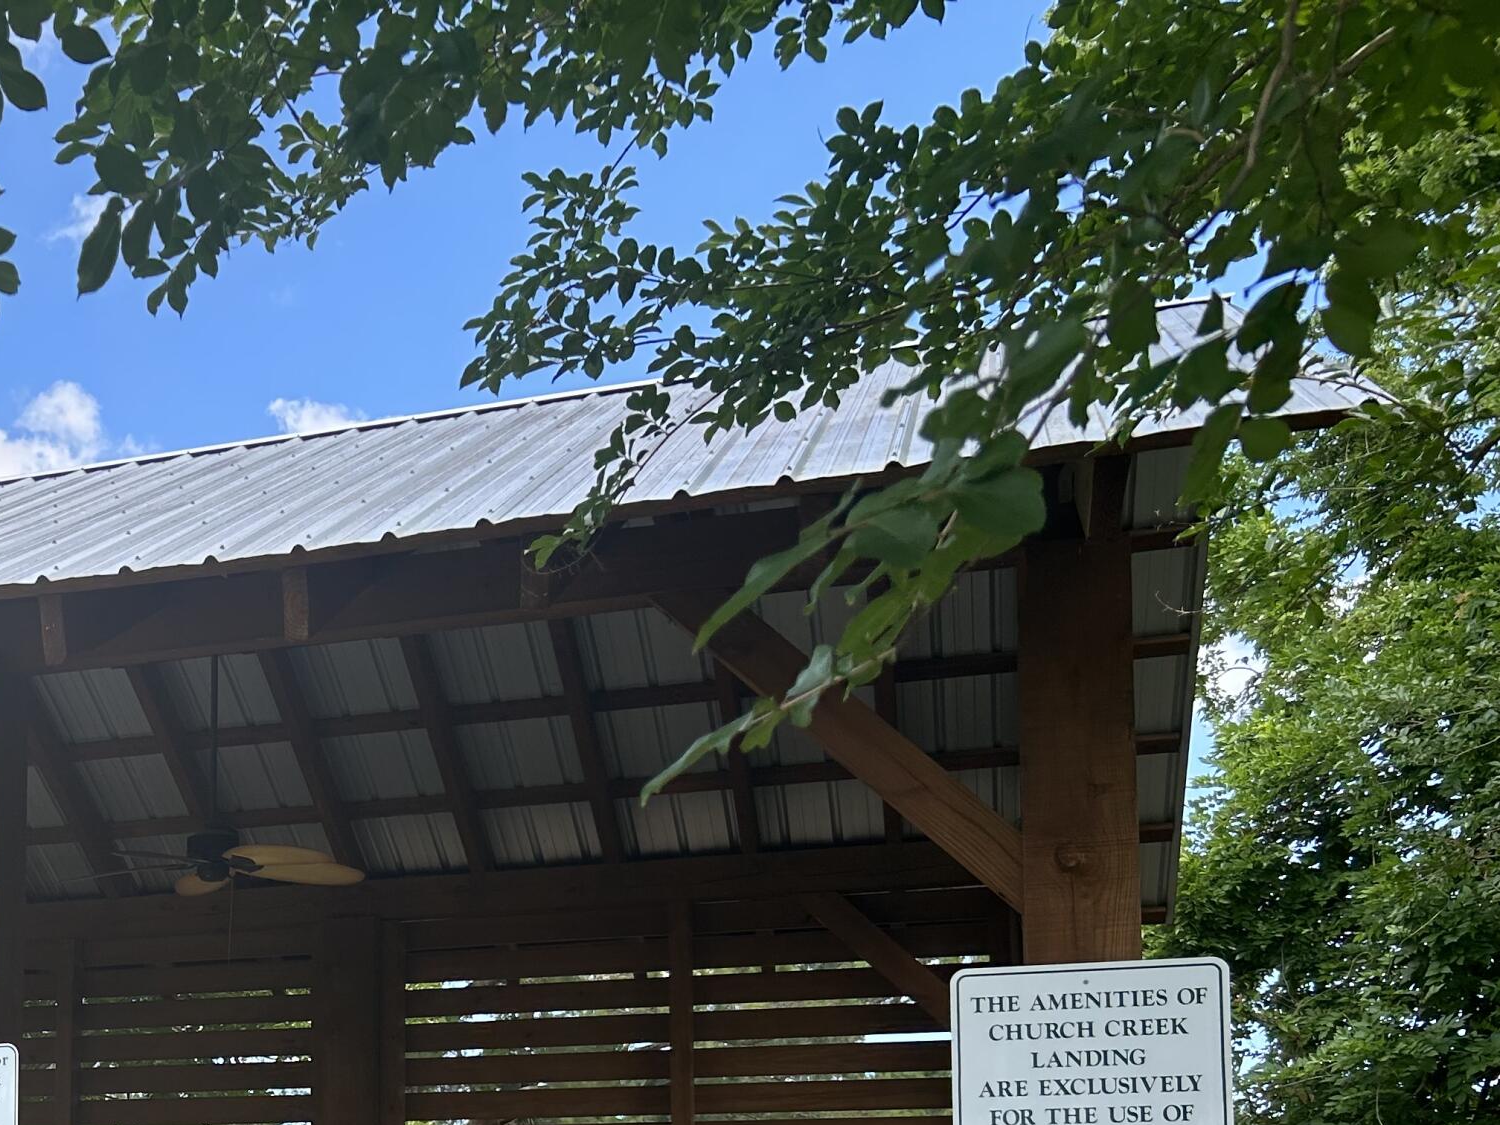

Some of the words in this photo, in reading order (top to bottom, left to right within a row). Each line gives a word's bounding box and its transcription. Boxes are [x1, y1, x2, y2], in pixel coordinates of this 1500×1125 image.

[970, 995, 1020, 1014] THE
[1029, 989, 1168, 1011] AMENITIES
[1177, 987, 1208, 1005] OF
[988, 1021, 1095, 1041] CHURCH
[1104, 1017, 1189, 1037] CREEK
[1031, 1048, 1146, 1069] LANDING
[979, 1080, 1028, 1098] ARE
[1039, 1074, 1203, 1096] EXCLUSIVELY
[989, 1109, 1035, 1125] FOR
[1045, 1107, 1098, 1125] THE
[1108, 1106, 1153, 1123] USE
[1162, 1104, 1194, 1122] OF
